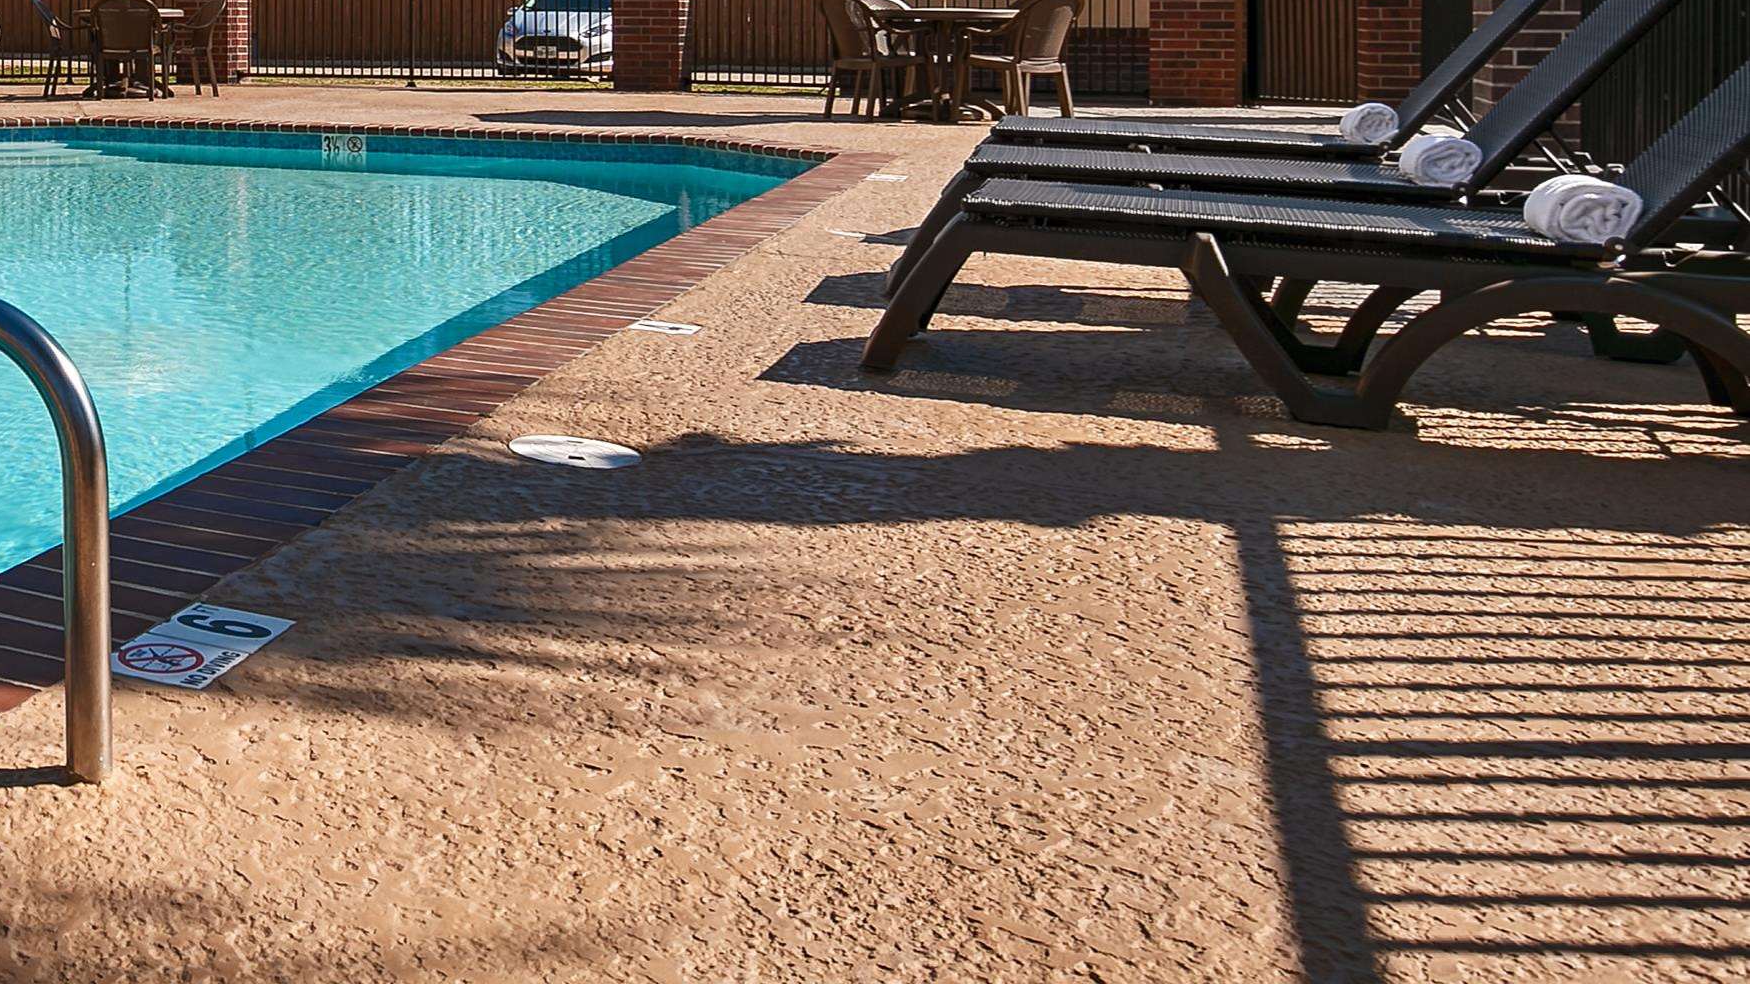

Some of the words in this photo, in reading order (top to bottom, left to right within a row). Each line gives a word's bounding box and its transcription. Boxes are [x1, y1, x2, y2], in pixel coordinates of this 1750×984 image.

[176, 614, 272, 639] 6
[180, 674, 208, 687] NO
[196, 651, 241, 676] DIVING
